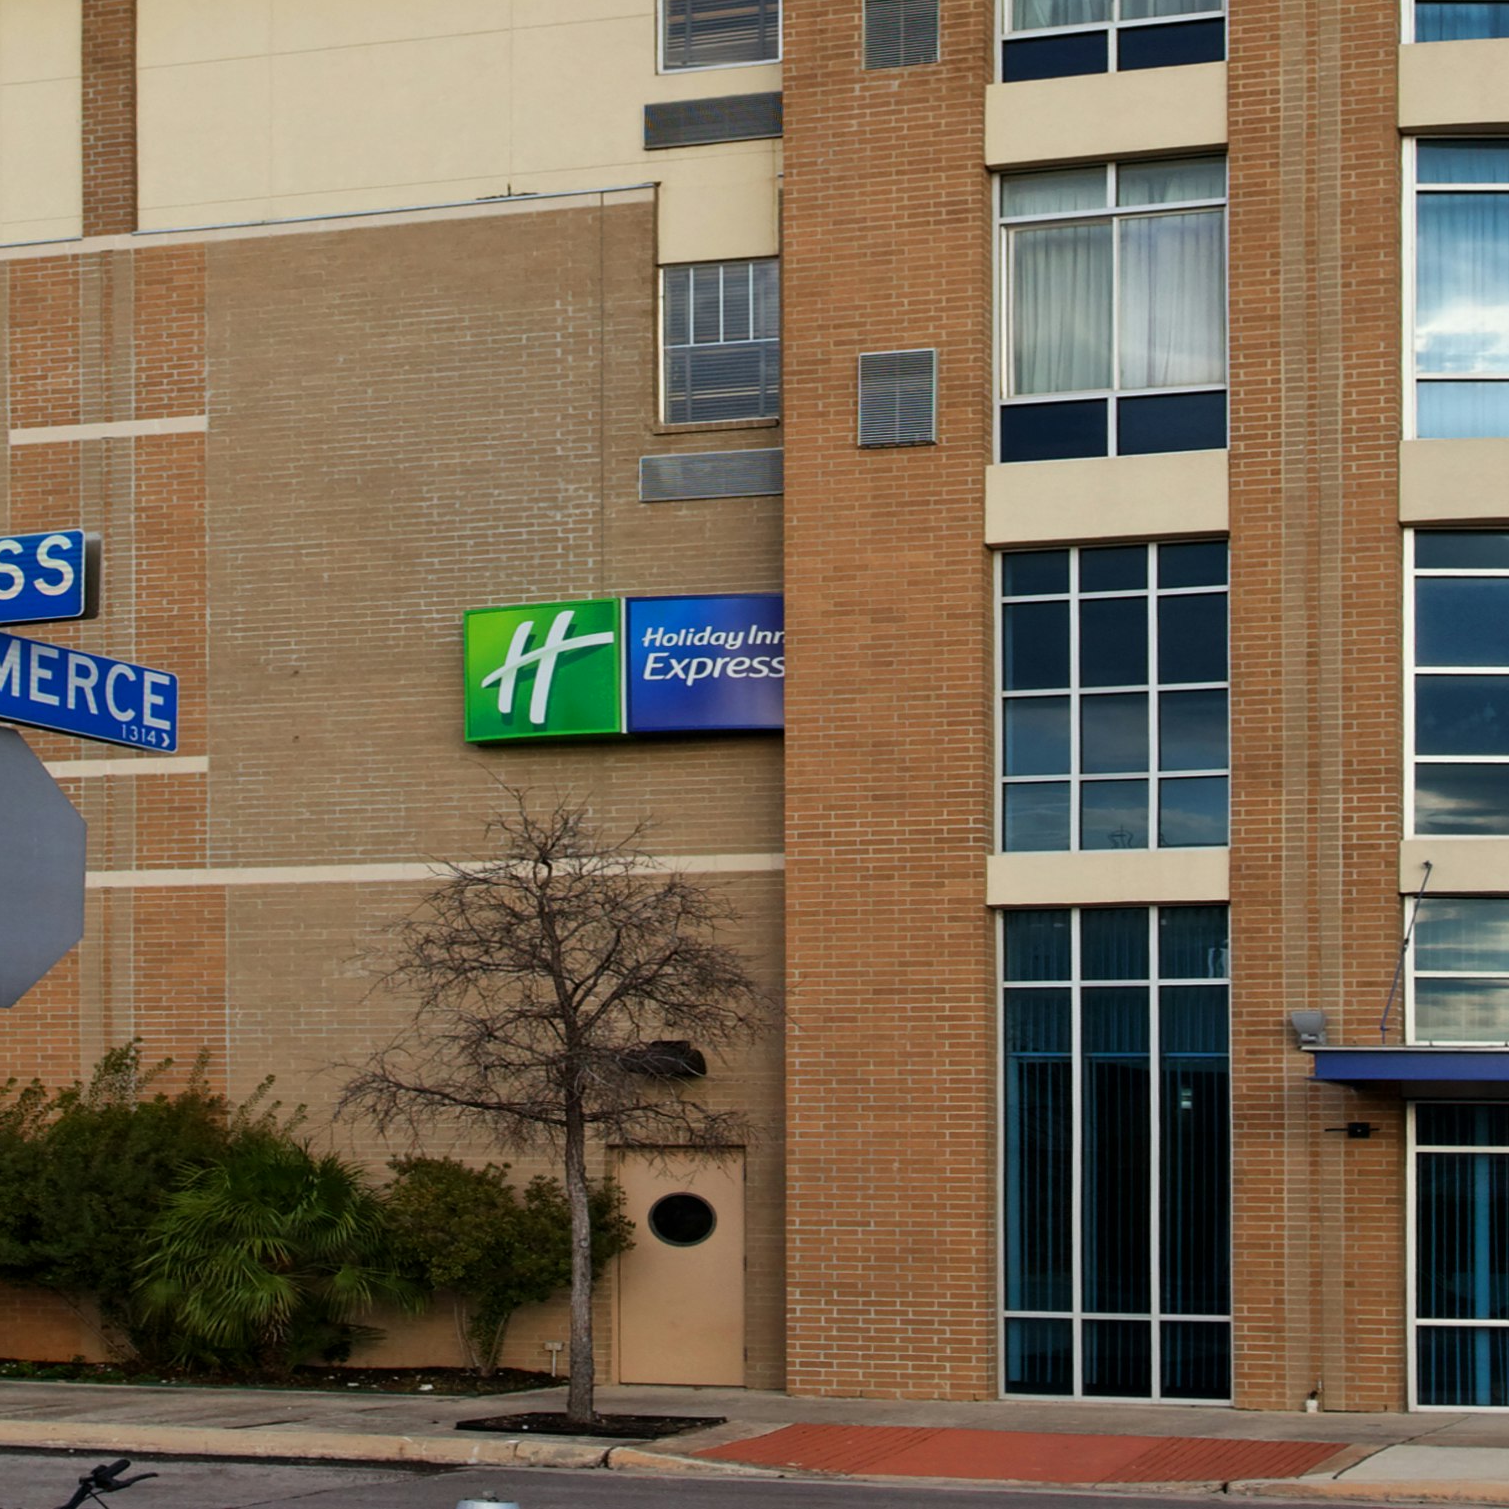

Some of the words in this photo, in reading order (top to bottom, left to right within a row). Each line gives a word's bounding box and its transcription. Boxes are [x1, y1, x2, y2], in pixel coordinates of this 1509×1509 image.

[642, 626, 745, 650] Holiday
[481, 610, 615, 724] H
[643, 652, 785, 686] Express
[121, 724, 156, 745] 1314
